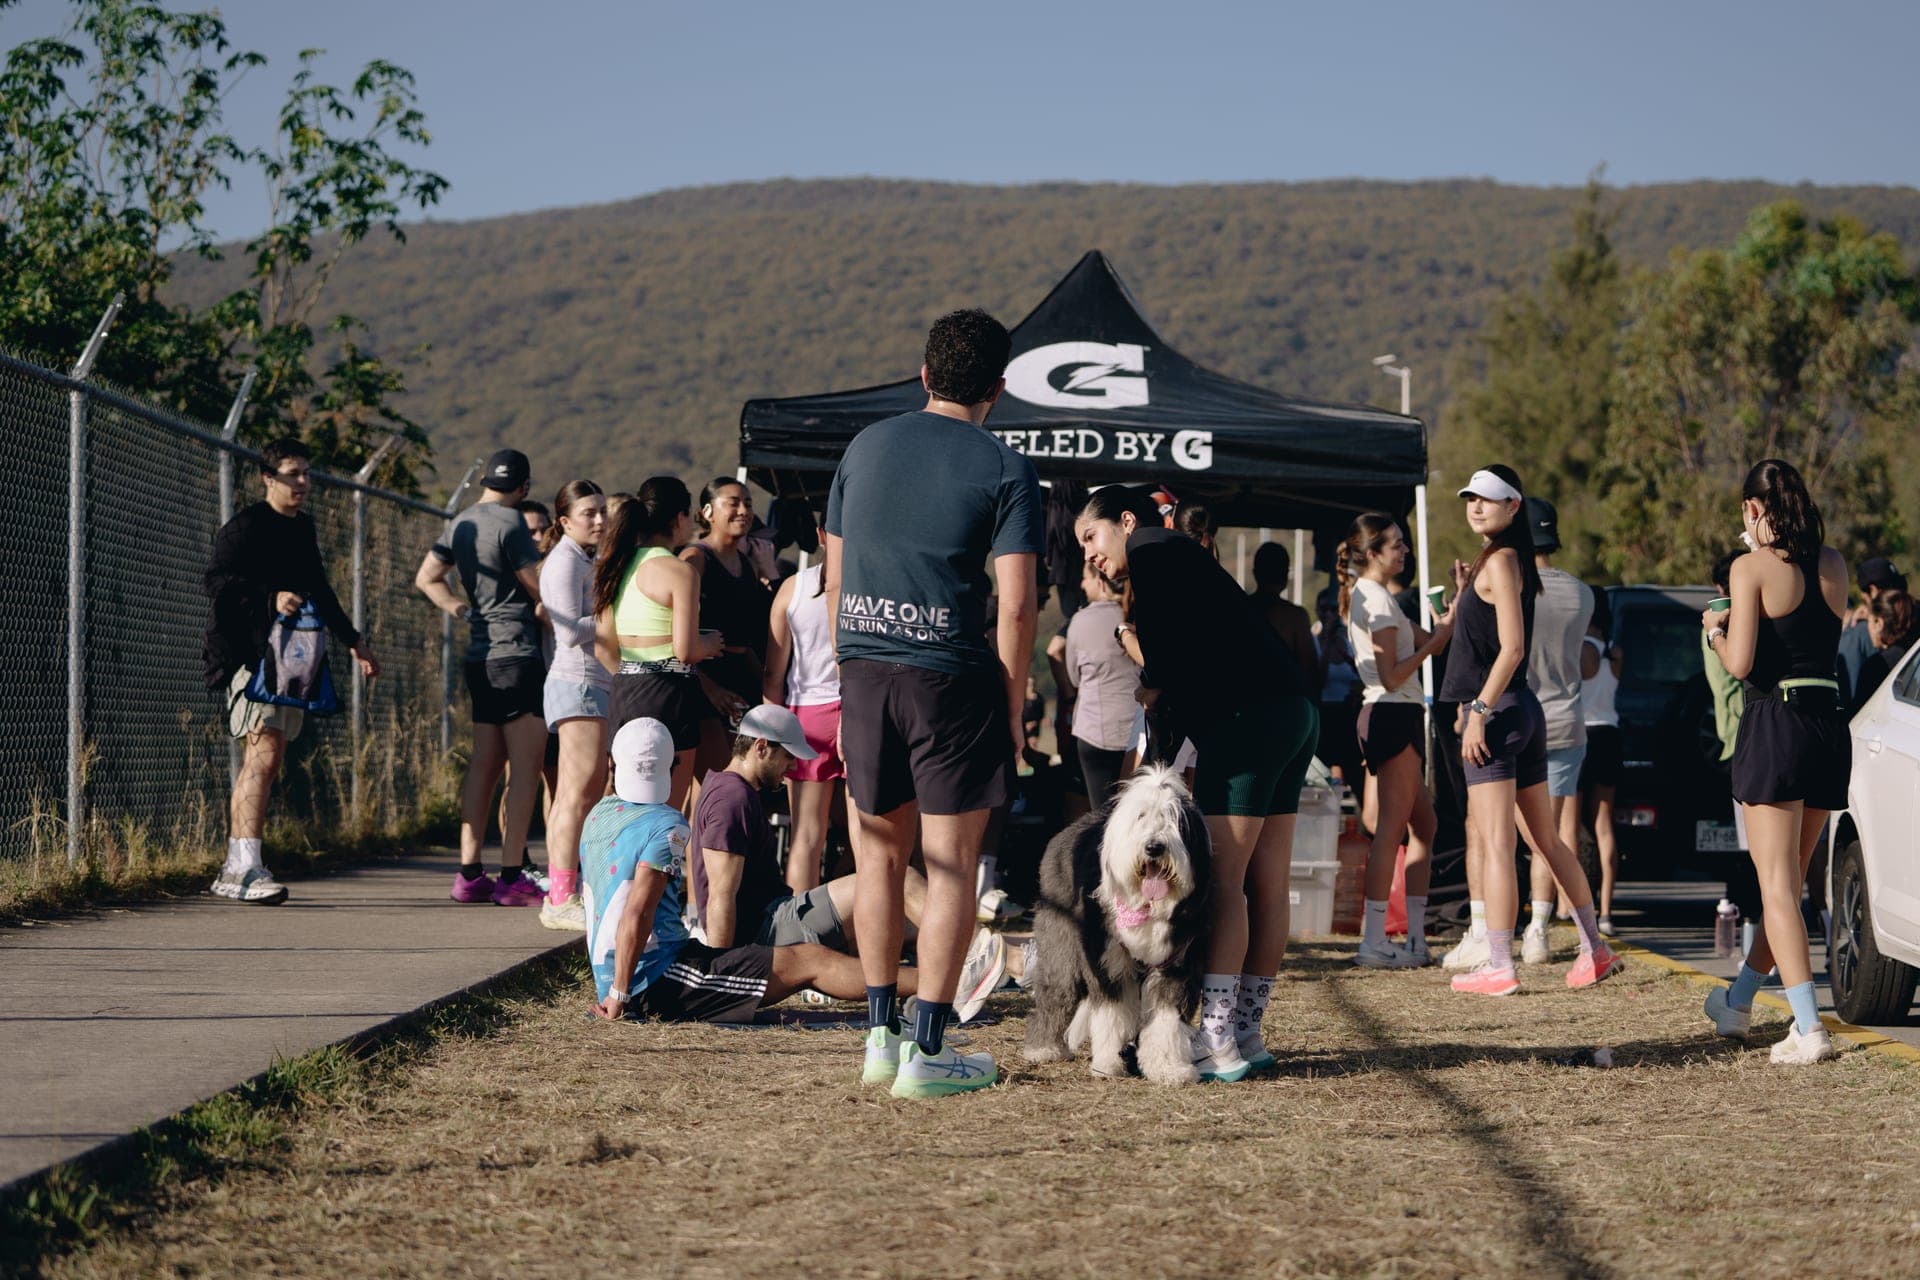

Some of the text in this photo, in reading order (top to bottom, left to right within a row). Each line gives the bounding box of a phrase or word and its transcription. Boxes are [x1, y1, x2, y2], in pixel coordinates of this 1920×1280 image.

[1004, 341, 1149, 409] G
[991, 430, 1213, 471] ELED BY G
[840, 617, 856, 631] WE
[859, 619, 888, 634] RUN
[892, 626, 913, 638] AS
[842, 592, 950, 627] WAVE ONE
